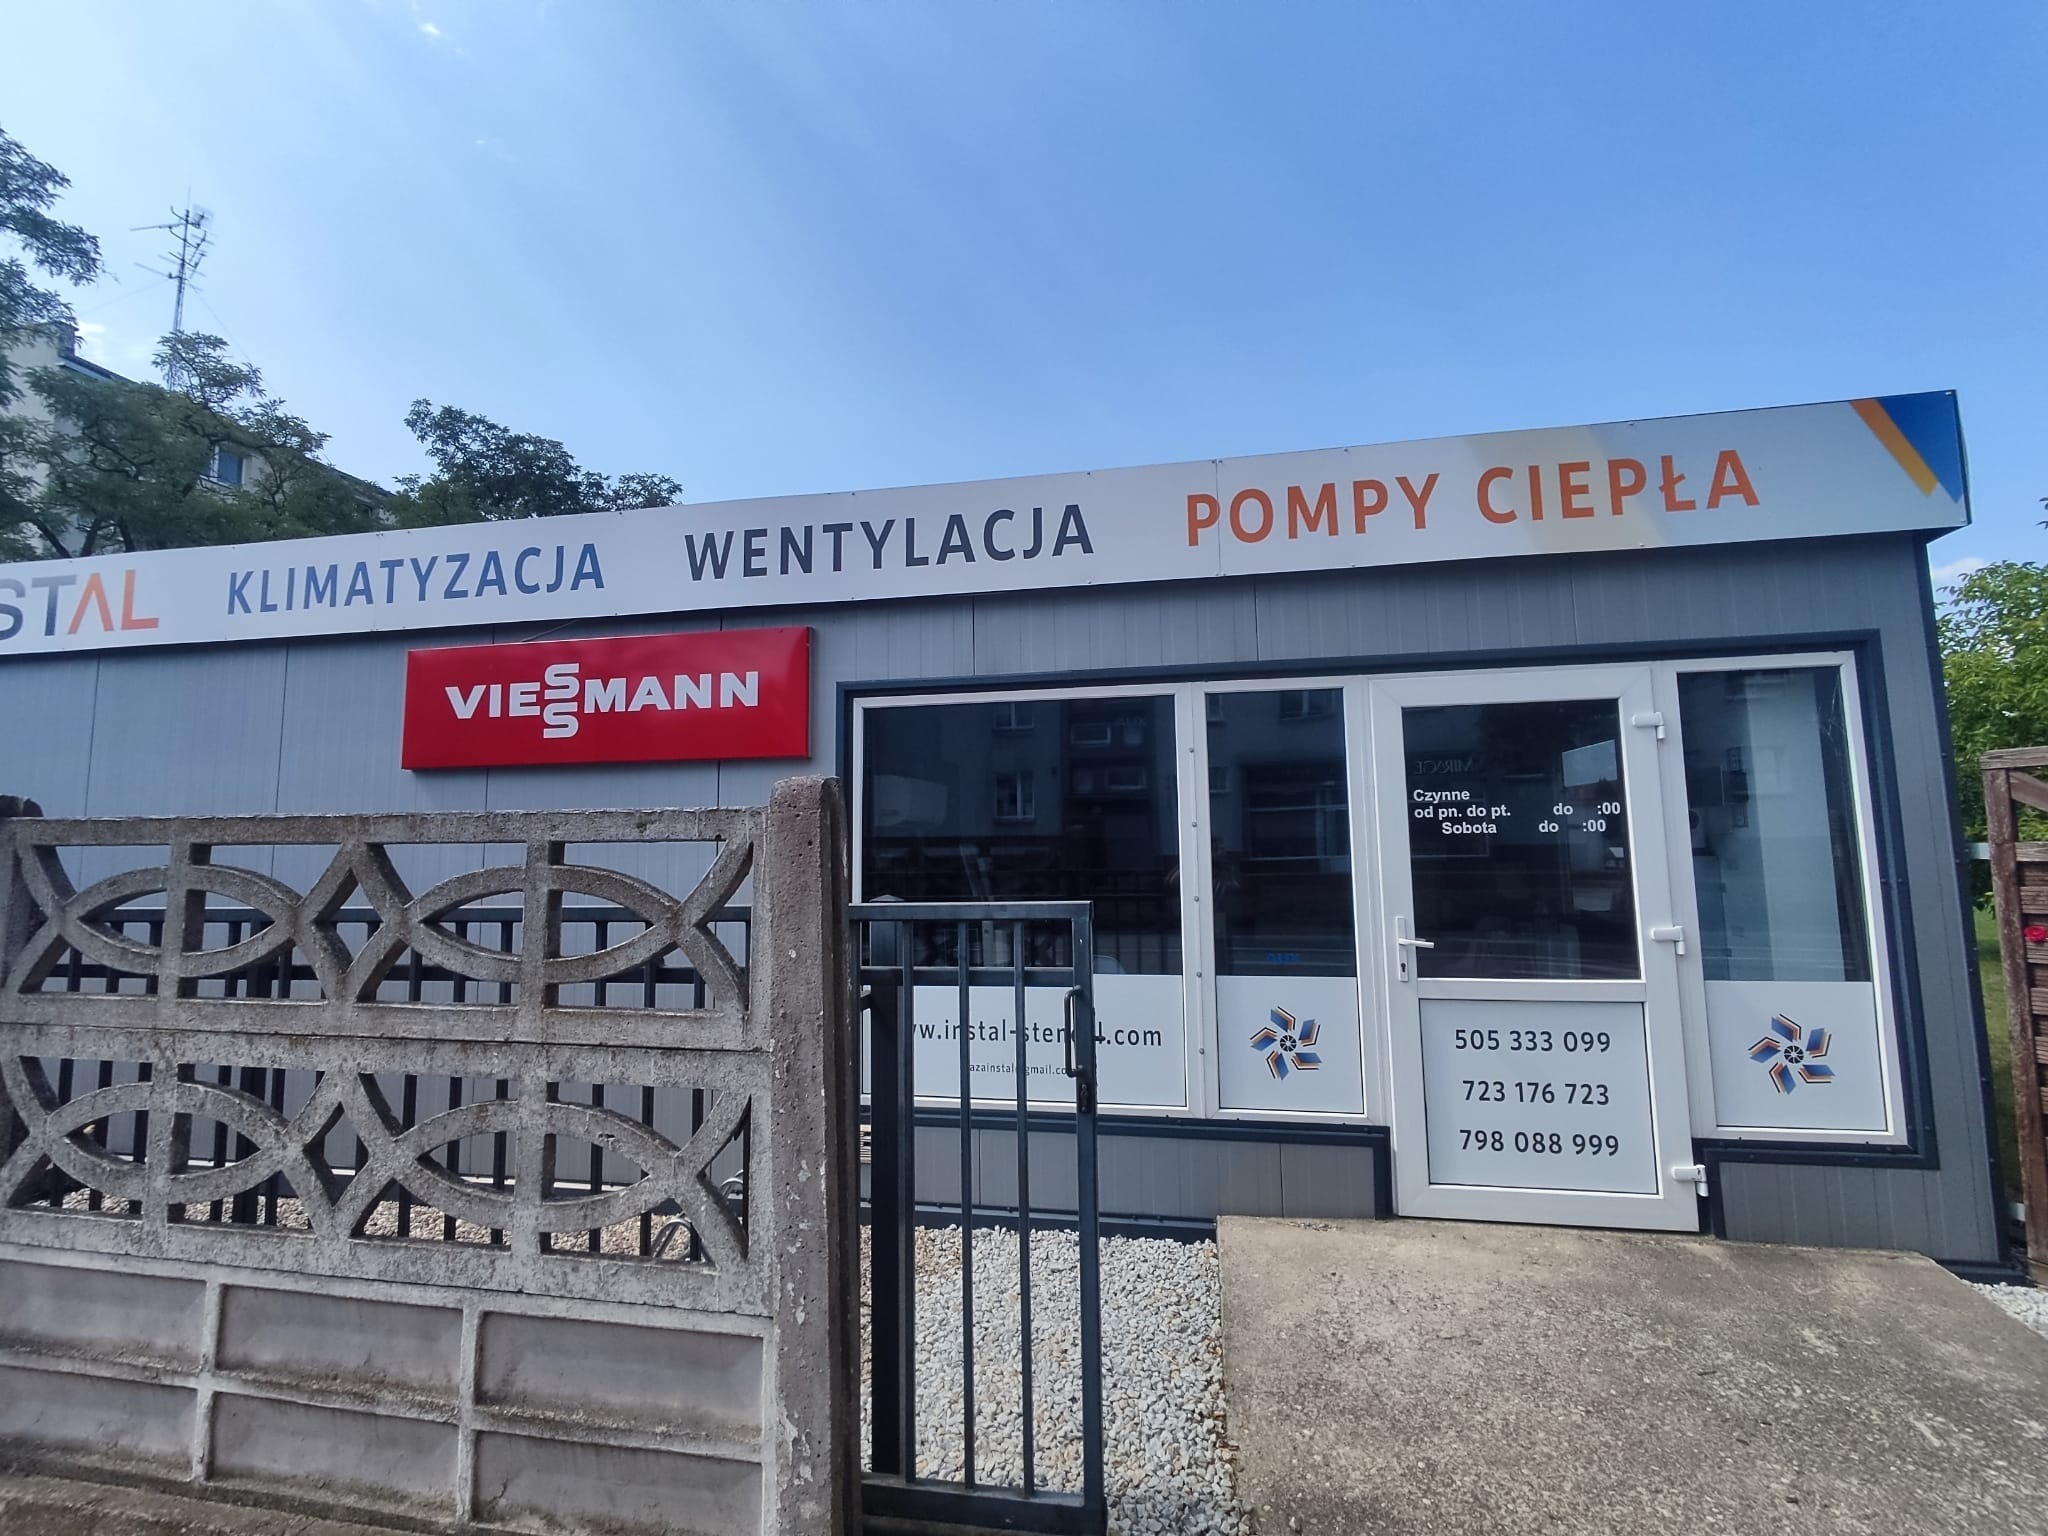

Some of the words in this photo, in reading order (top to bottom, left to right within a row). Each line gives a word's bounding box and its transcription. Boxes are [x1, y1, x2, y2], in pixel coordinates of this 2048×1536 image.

[227, 543, 605, 615] KLIMATYZACJA
[685, 504, 1093, 580] WENTYLACJA
[1186, 473, 1440, 546] POMPY
[1477, 449, 1760, 525] CIEPŁA
[445, 663, 758, 738] VIESSMANN
[1413, 789, 1470, 804] Czynne
[1414, 805, 1434, 818] od
[1438, 807, 1462, 821] pn.
[1466, 804, 1487, 817] do
[1491, 804, 1511, 820] pt.
[1553, 802, 1574, 816] do
[1441, 821, 1497, 835] Sobota
[1538, 820, 1559, 833] do
[1455, 1029, 1500, 1051] 505
[1509, 1030, 1553, 1052] 333
[1563, 1031, 1611, 1053] 099
[1462, 1080, 1506, 1102] 723
[1514, 1081, 1555, 1104] 176
[1564, 1083, 1609, 1106] 723
[1459, 1129, 1505, 1152] 798
[1514, 1131, 1563, 1155] 088
[1572, 1133, 1619, 1157] 999
